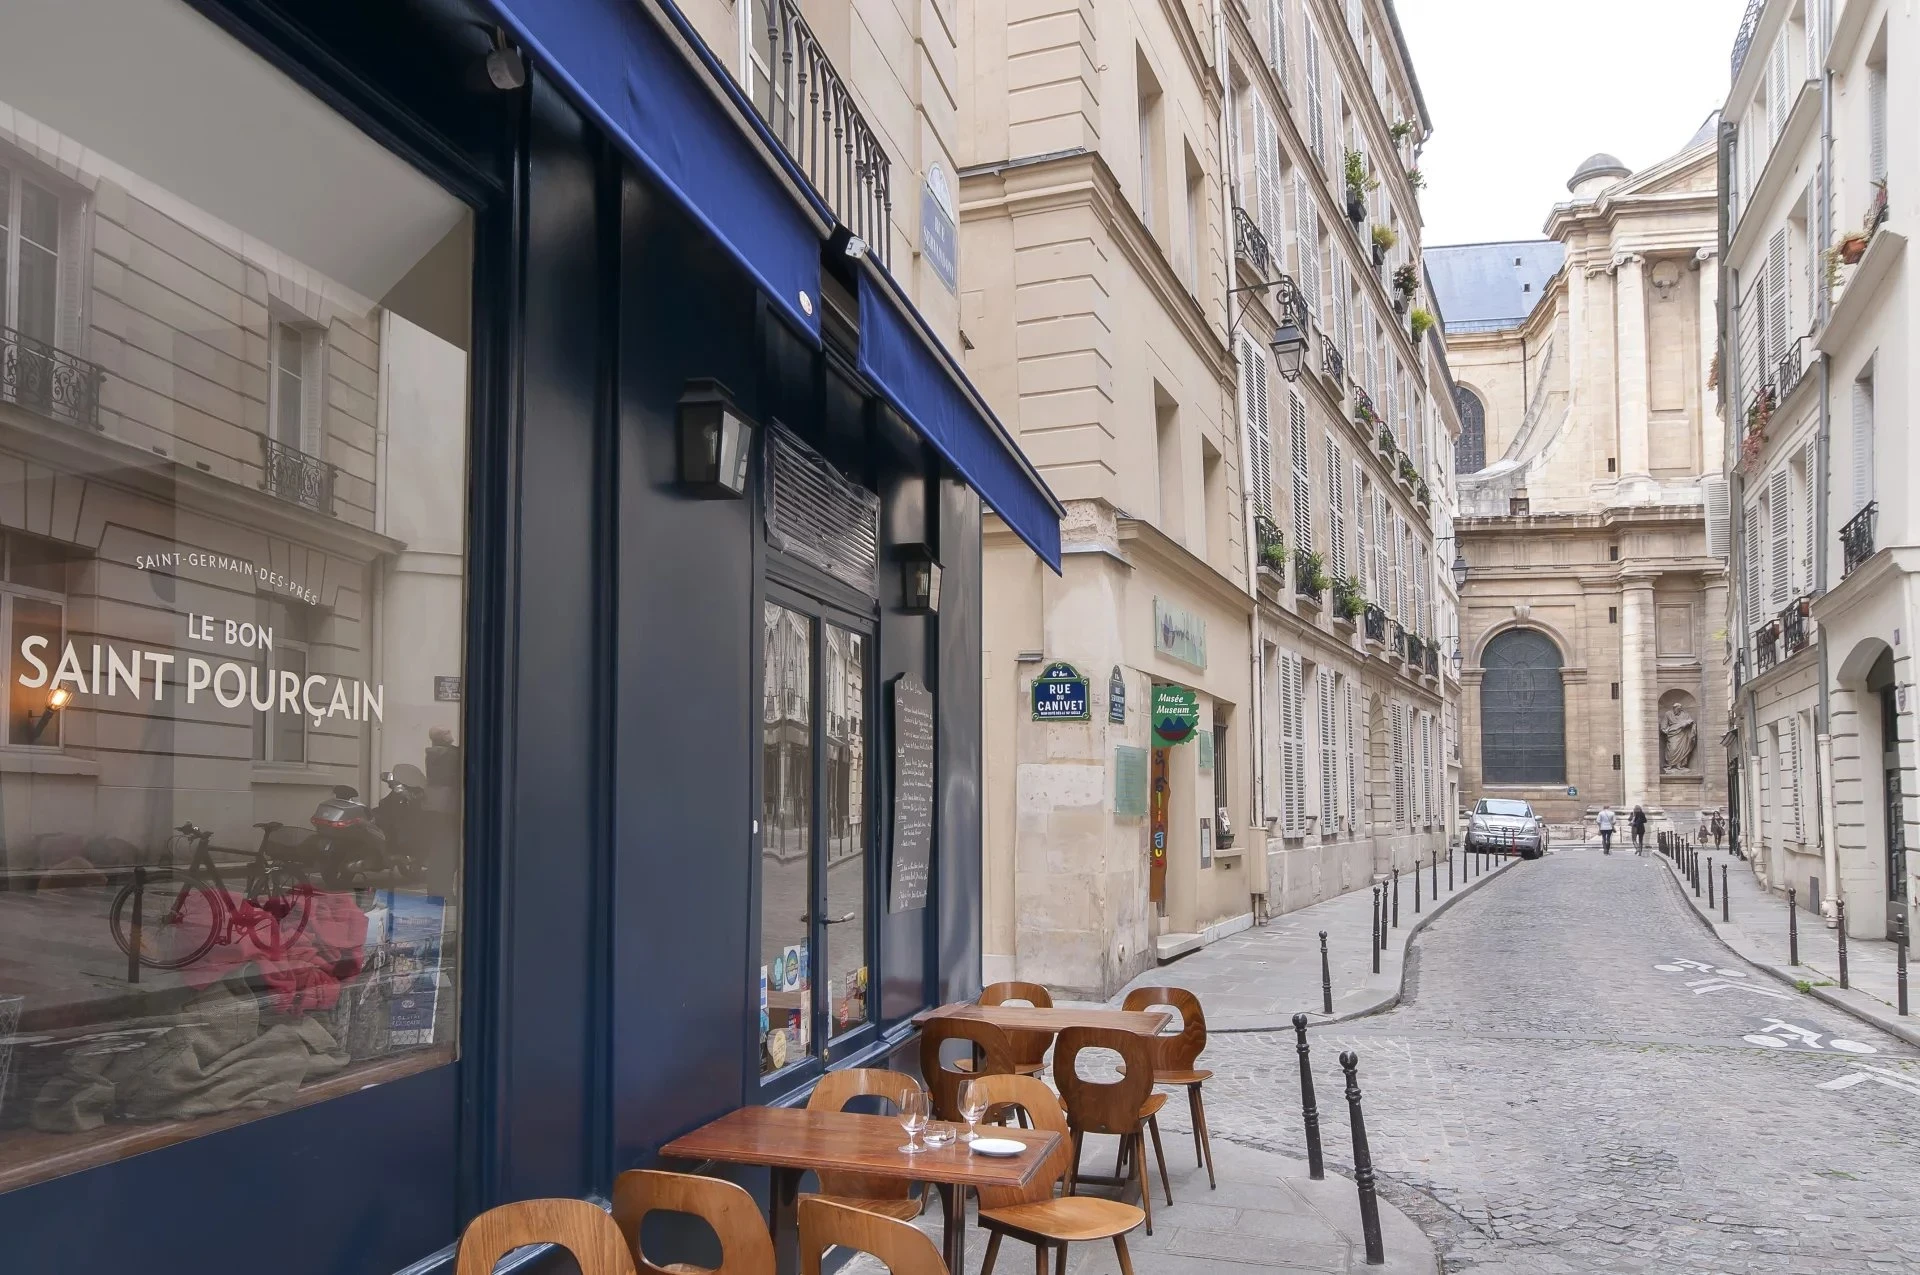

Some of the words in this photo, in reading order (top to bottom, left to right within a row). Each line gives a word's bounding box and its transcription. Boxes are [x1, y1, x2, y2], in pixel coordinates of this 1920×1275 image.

[136, 552, 317, 606] SAINT-GERMAIN-DES-PRÉS
[188, 612, 214, 642] LE
[224, 618, 273, 652] BON
[18, 634, 175, 700] SAINT
[187, 657, 384, 728] POURÇAIN
[1049, 684, 1071, 695] RUE
[1157, 693, 1184, 703] Musée
[1037, 700, 1084, 711] CANIVET
[1156, 705, 1190, 714] Museum
